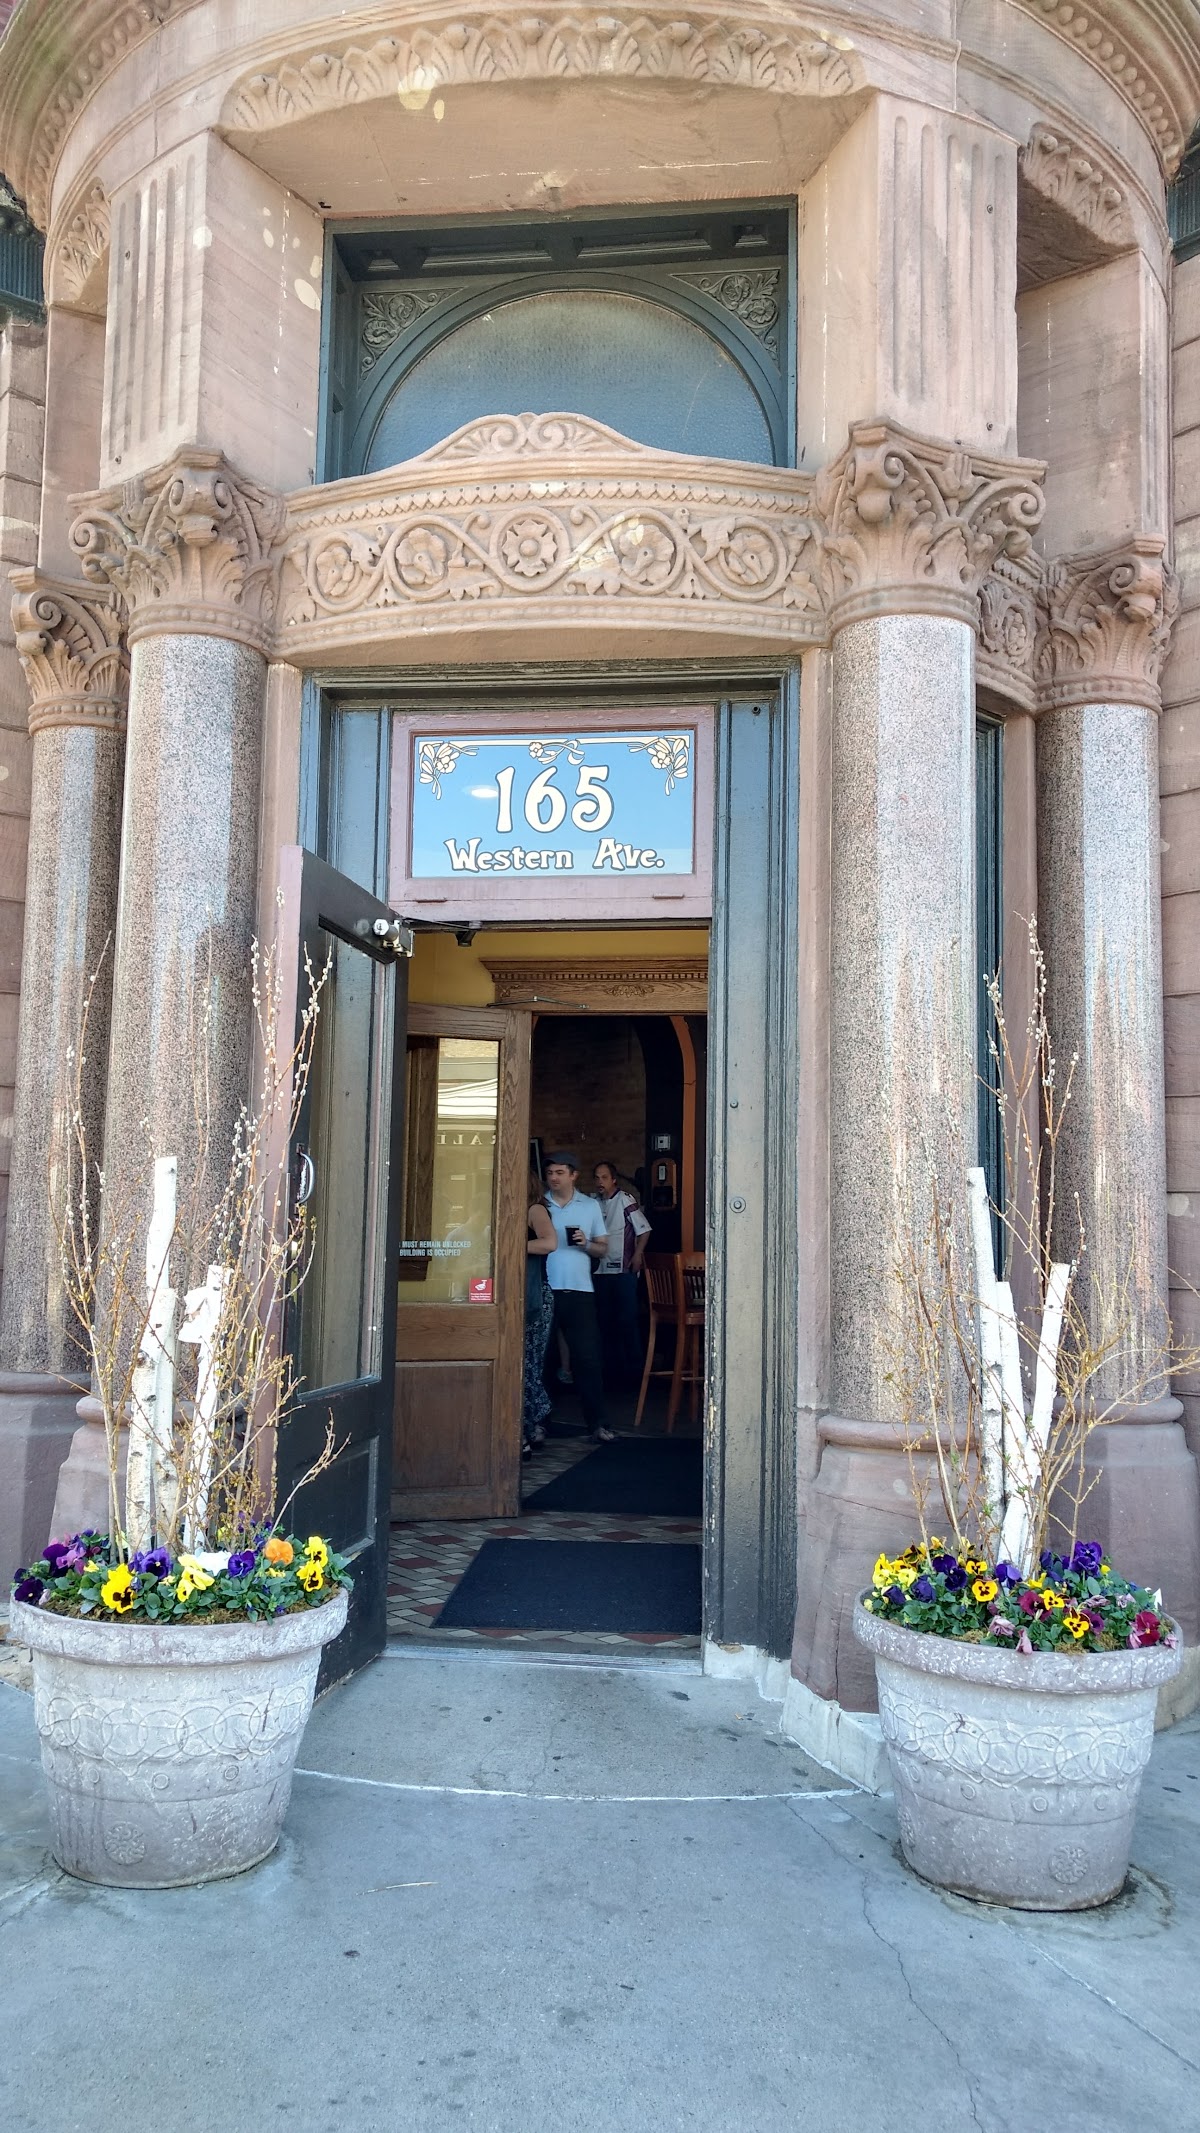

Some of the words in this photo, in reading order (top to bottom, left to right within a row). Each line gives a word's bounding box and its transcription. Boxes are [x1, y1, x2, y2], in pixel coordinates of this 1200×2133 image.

[495, 764, 614, 833] 165
[443, 837, 574, 873] Western
[592, 837, 665, 871] Ave.
[399, 1249, 426, 1257] BUILDING
[427, 1249, 433, 1257] IS
[434, 1249, 461, 1257] OCCUPIED
